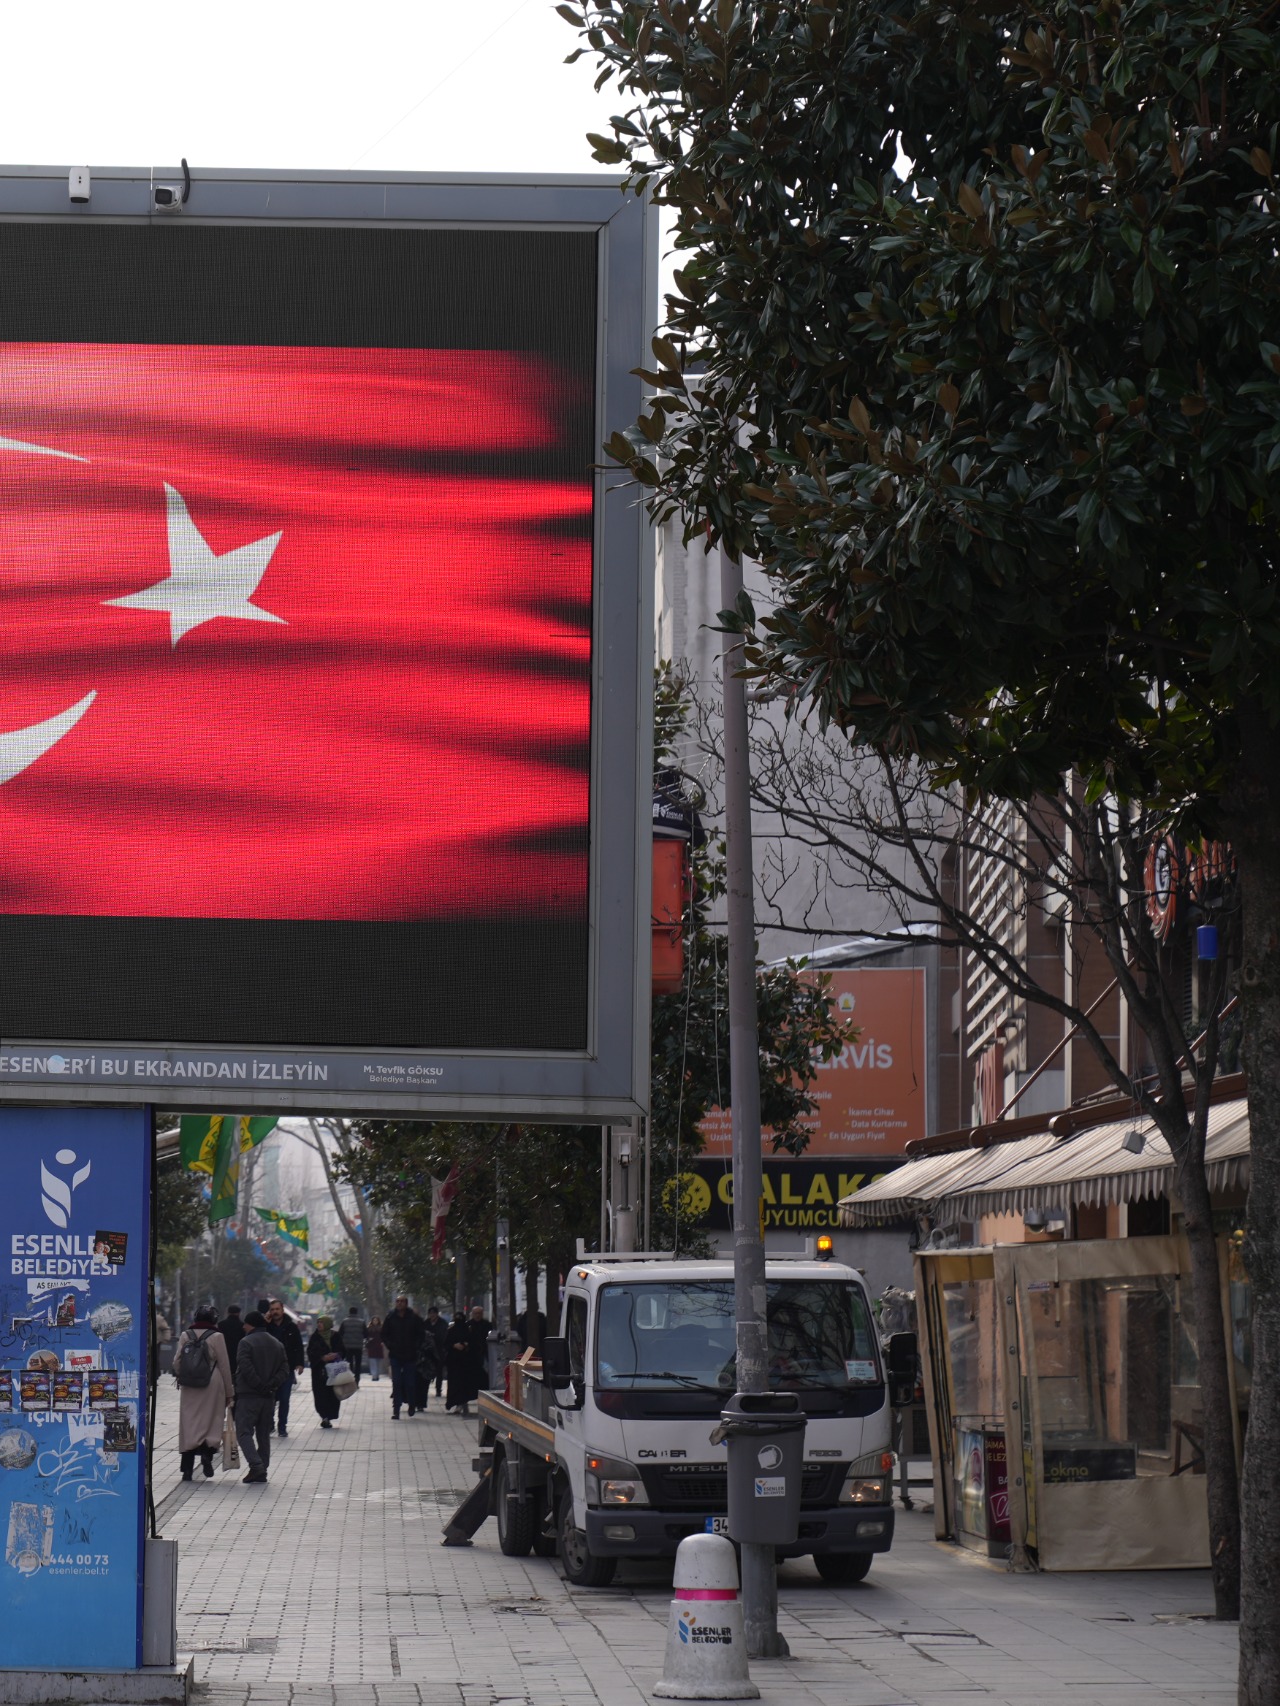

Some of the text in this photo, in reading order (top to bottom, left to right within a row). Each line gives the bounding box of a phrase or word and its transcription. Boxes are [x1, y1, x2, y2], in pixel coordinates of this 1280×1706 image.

[101, 1059, 128, 1076] BU
[134, 1060, 247, 1079] EKRANDAN
[252, 1059, 328, 1081] İZLEYİN
[363, 1065, 443, 1076] M. Tevfik GÖKSU
[369, 1075, 437, 1086] Belediye Başkanı
[851, 1120, 869, 1128] Data
[871, 1120, 907, 1128] Kurtarma
[11, 1235, 96, 1256] ESENLE
[993, 1453, 1007, 1461] LEZ
[49, 1555, 109, 1565] 444 00 73
[49, 1566, 109, 1575] esenler.bel.tr
[692, 1627, 731, 1635] ESENLER
